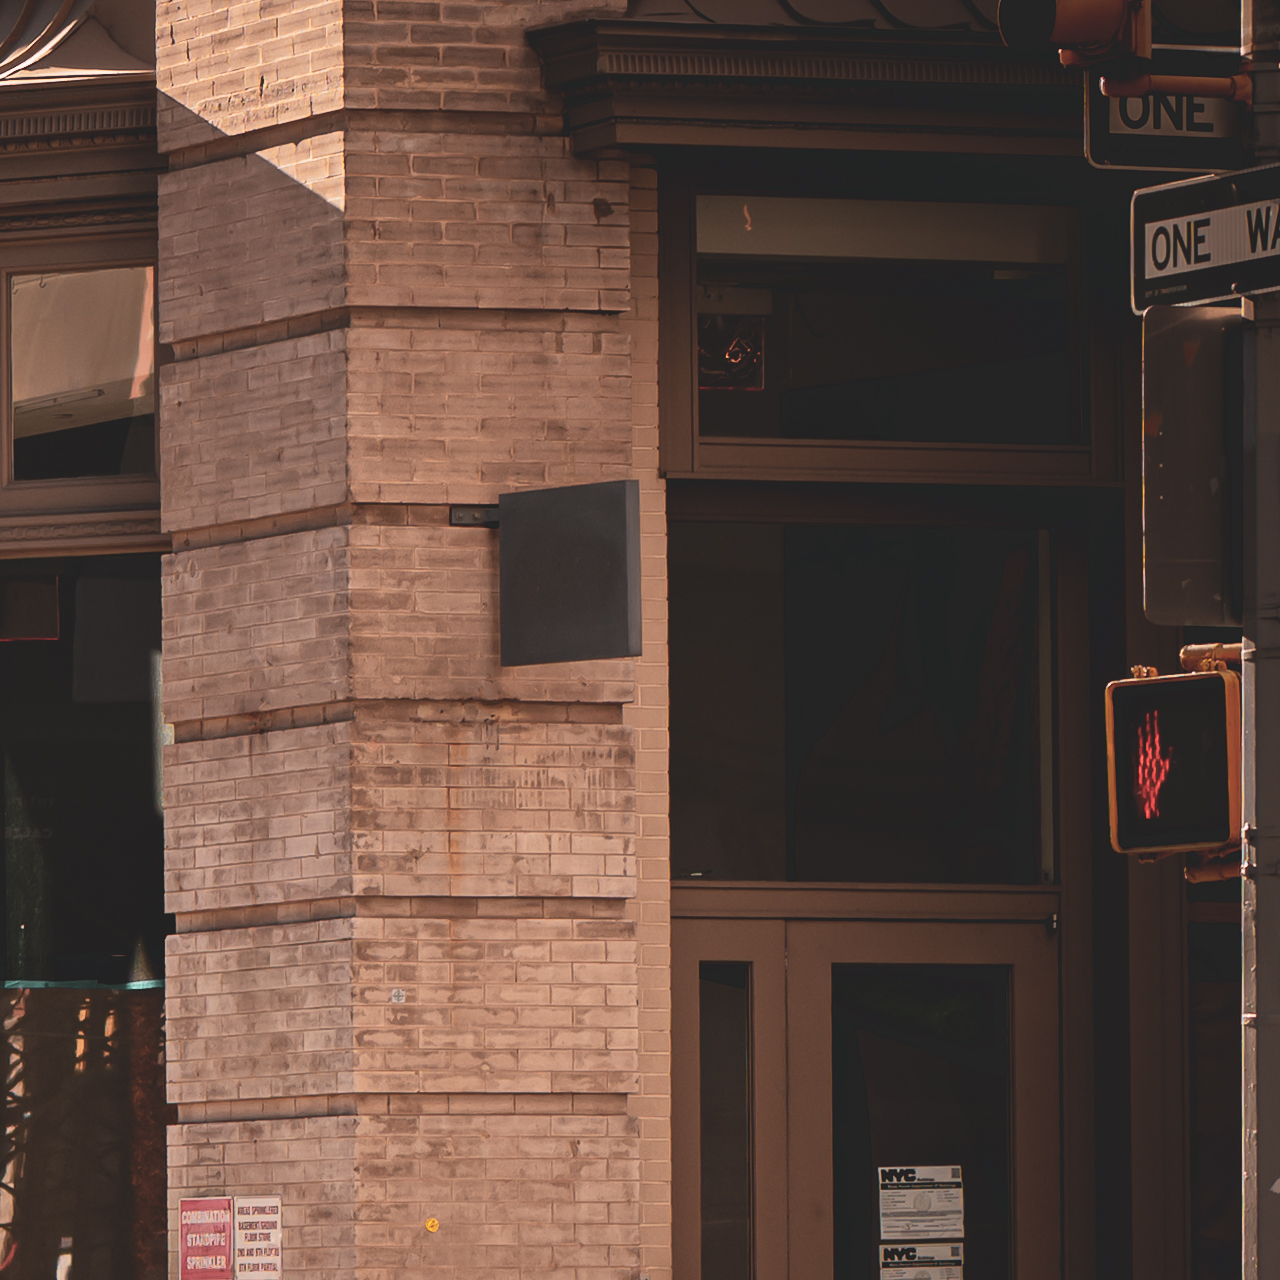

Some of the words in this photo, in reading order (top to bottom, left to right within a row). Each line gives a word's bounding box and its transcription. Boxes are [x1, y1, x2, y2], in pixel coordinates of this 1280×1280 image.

[1119, 96, 1214, 132] ONE
[1151, 218, 1211, 271] ONE
[881, 1169, 916, 1182] NYC
[182, 1210, 230, 1224] COMBINATION
[187, 1233, 226, 1247] STANDPIPE
[884, 1248, 916, 1260] NYC
[187, 1256, 226, 1270] SPRINKLER
